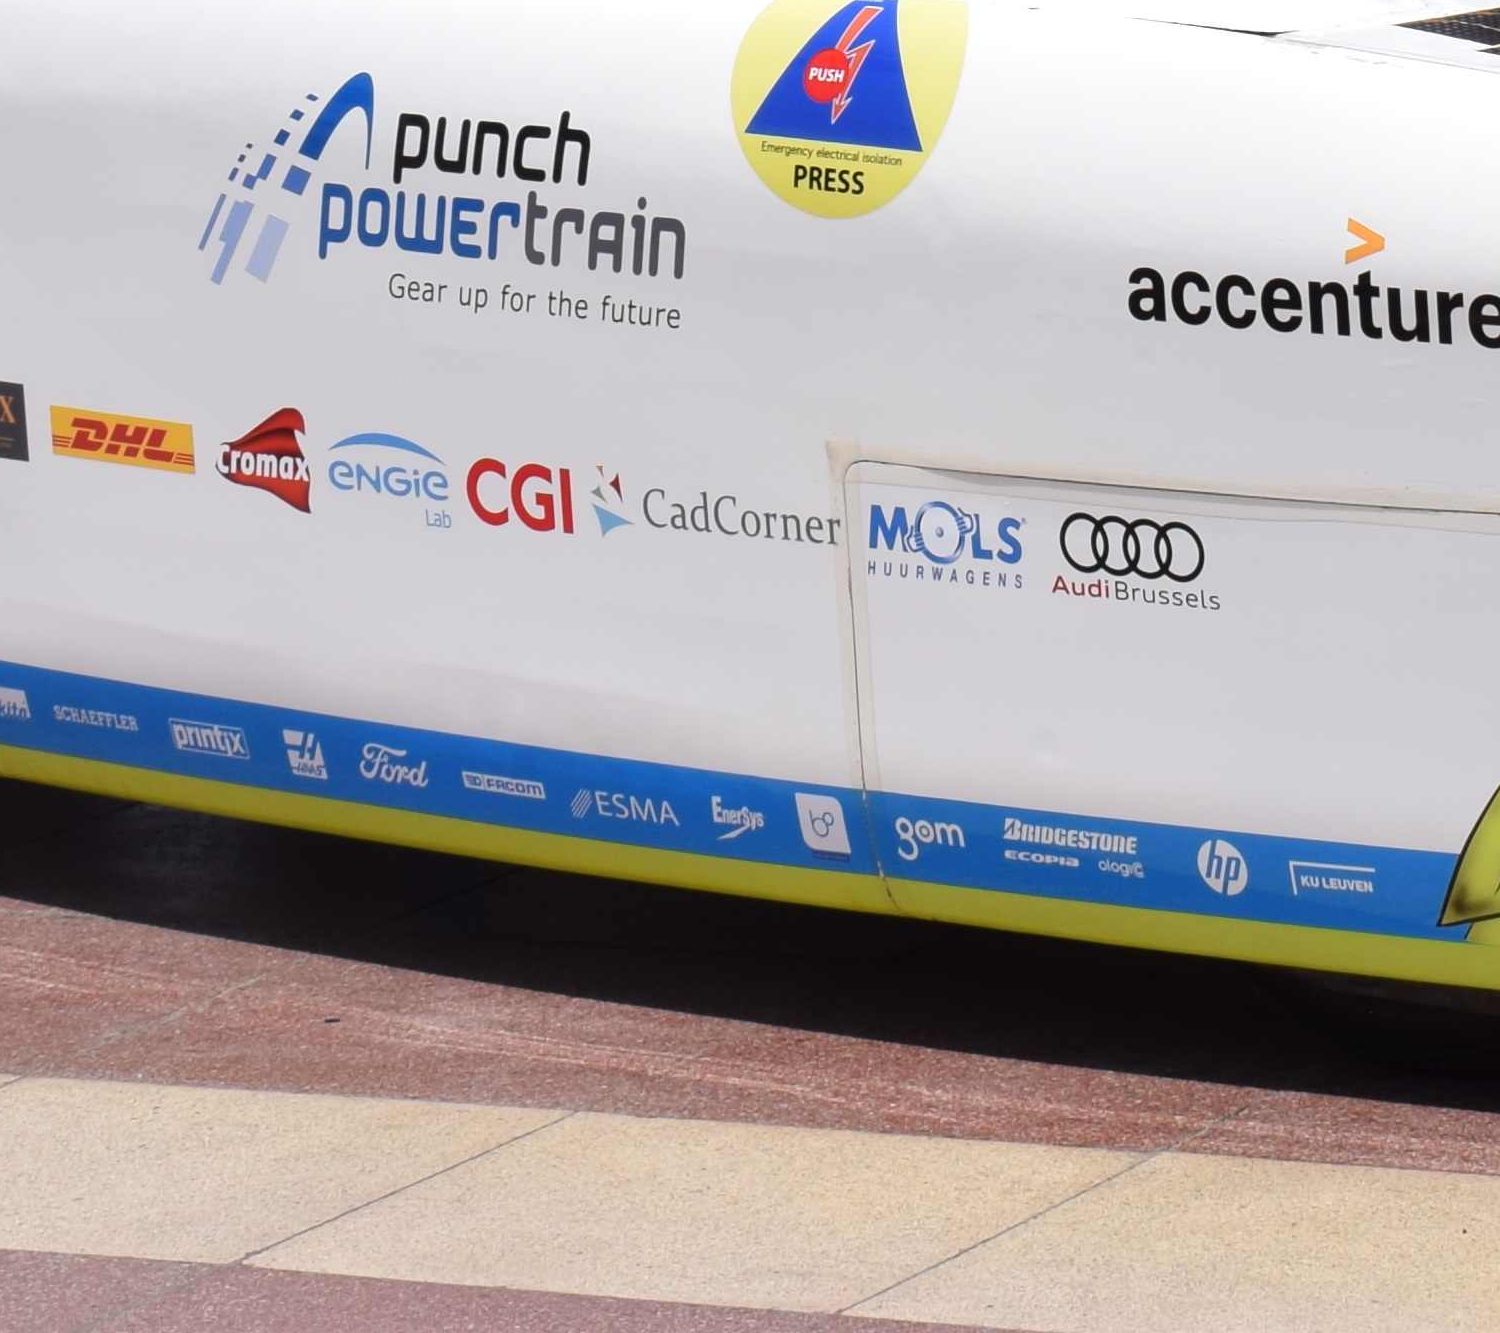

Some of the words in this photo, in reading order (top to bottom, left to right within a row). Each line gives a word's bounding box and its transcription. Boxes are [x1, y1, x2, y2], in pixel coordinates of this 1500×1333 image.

[808, 66, 845, 84] PUSH
[393, 109, 592, 187] punch
[761, 140, 814, 159] Emergency
[816, 147, 860, 163] electrical
[861, 153, 903, 167] isolation
[792, 164, 865, 196] PRESS
[388, 272, 448, 305] Gear
[457, 284, 489, 315] up
[500, 284, 537, 314] for
[547, 290, 588, 321] the
[600, 294, 682, 330] future
[69, 416, 176, 464] DHL
[217, 444, 311, 483] Cromax
[465, 456, 575, 536] CGI
[425, 508, 452, 529] Lab
[641, 487, 842, 546] CadCorner
[868, 500, 1024, 566] MOLS
[866, 560, 1024, 590] HUURWAGENS
[52, 704, 140, 733] SCHAEFFLER
[359, 742, 429, 788] Ford
[595, 790, 681, 828] ESMA
[711, 795, 765, 830] EnerSys
[895, 816, 966, 861] gom
[1002, 817, 1138, 855] BRIDGESTONE
[1203, 839, 1243, 895] hp
[1300, 874, 1320, 889] KU
[1322, 875, 1375, 894] LEUVEN
